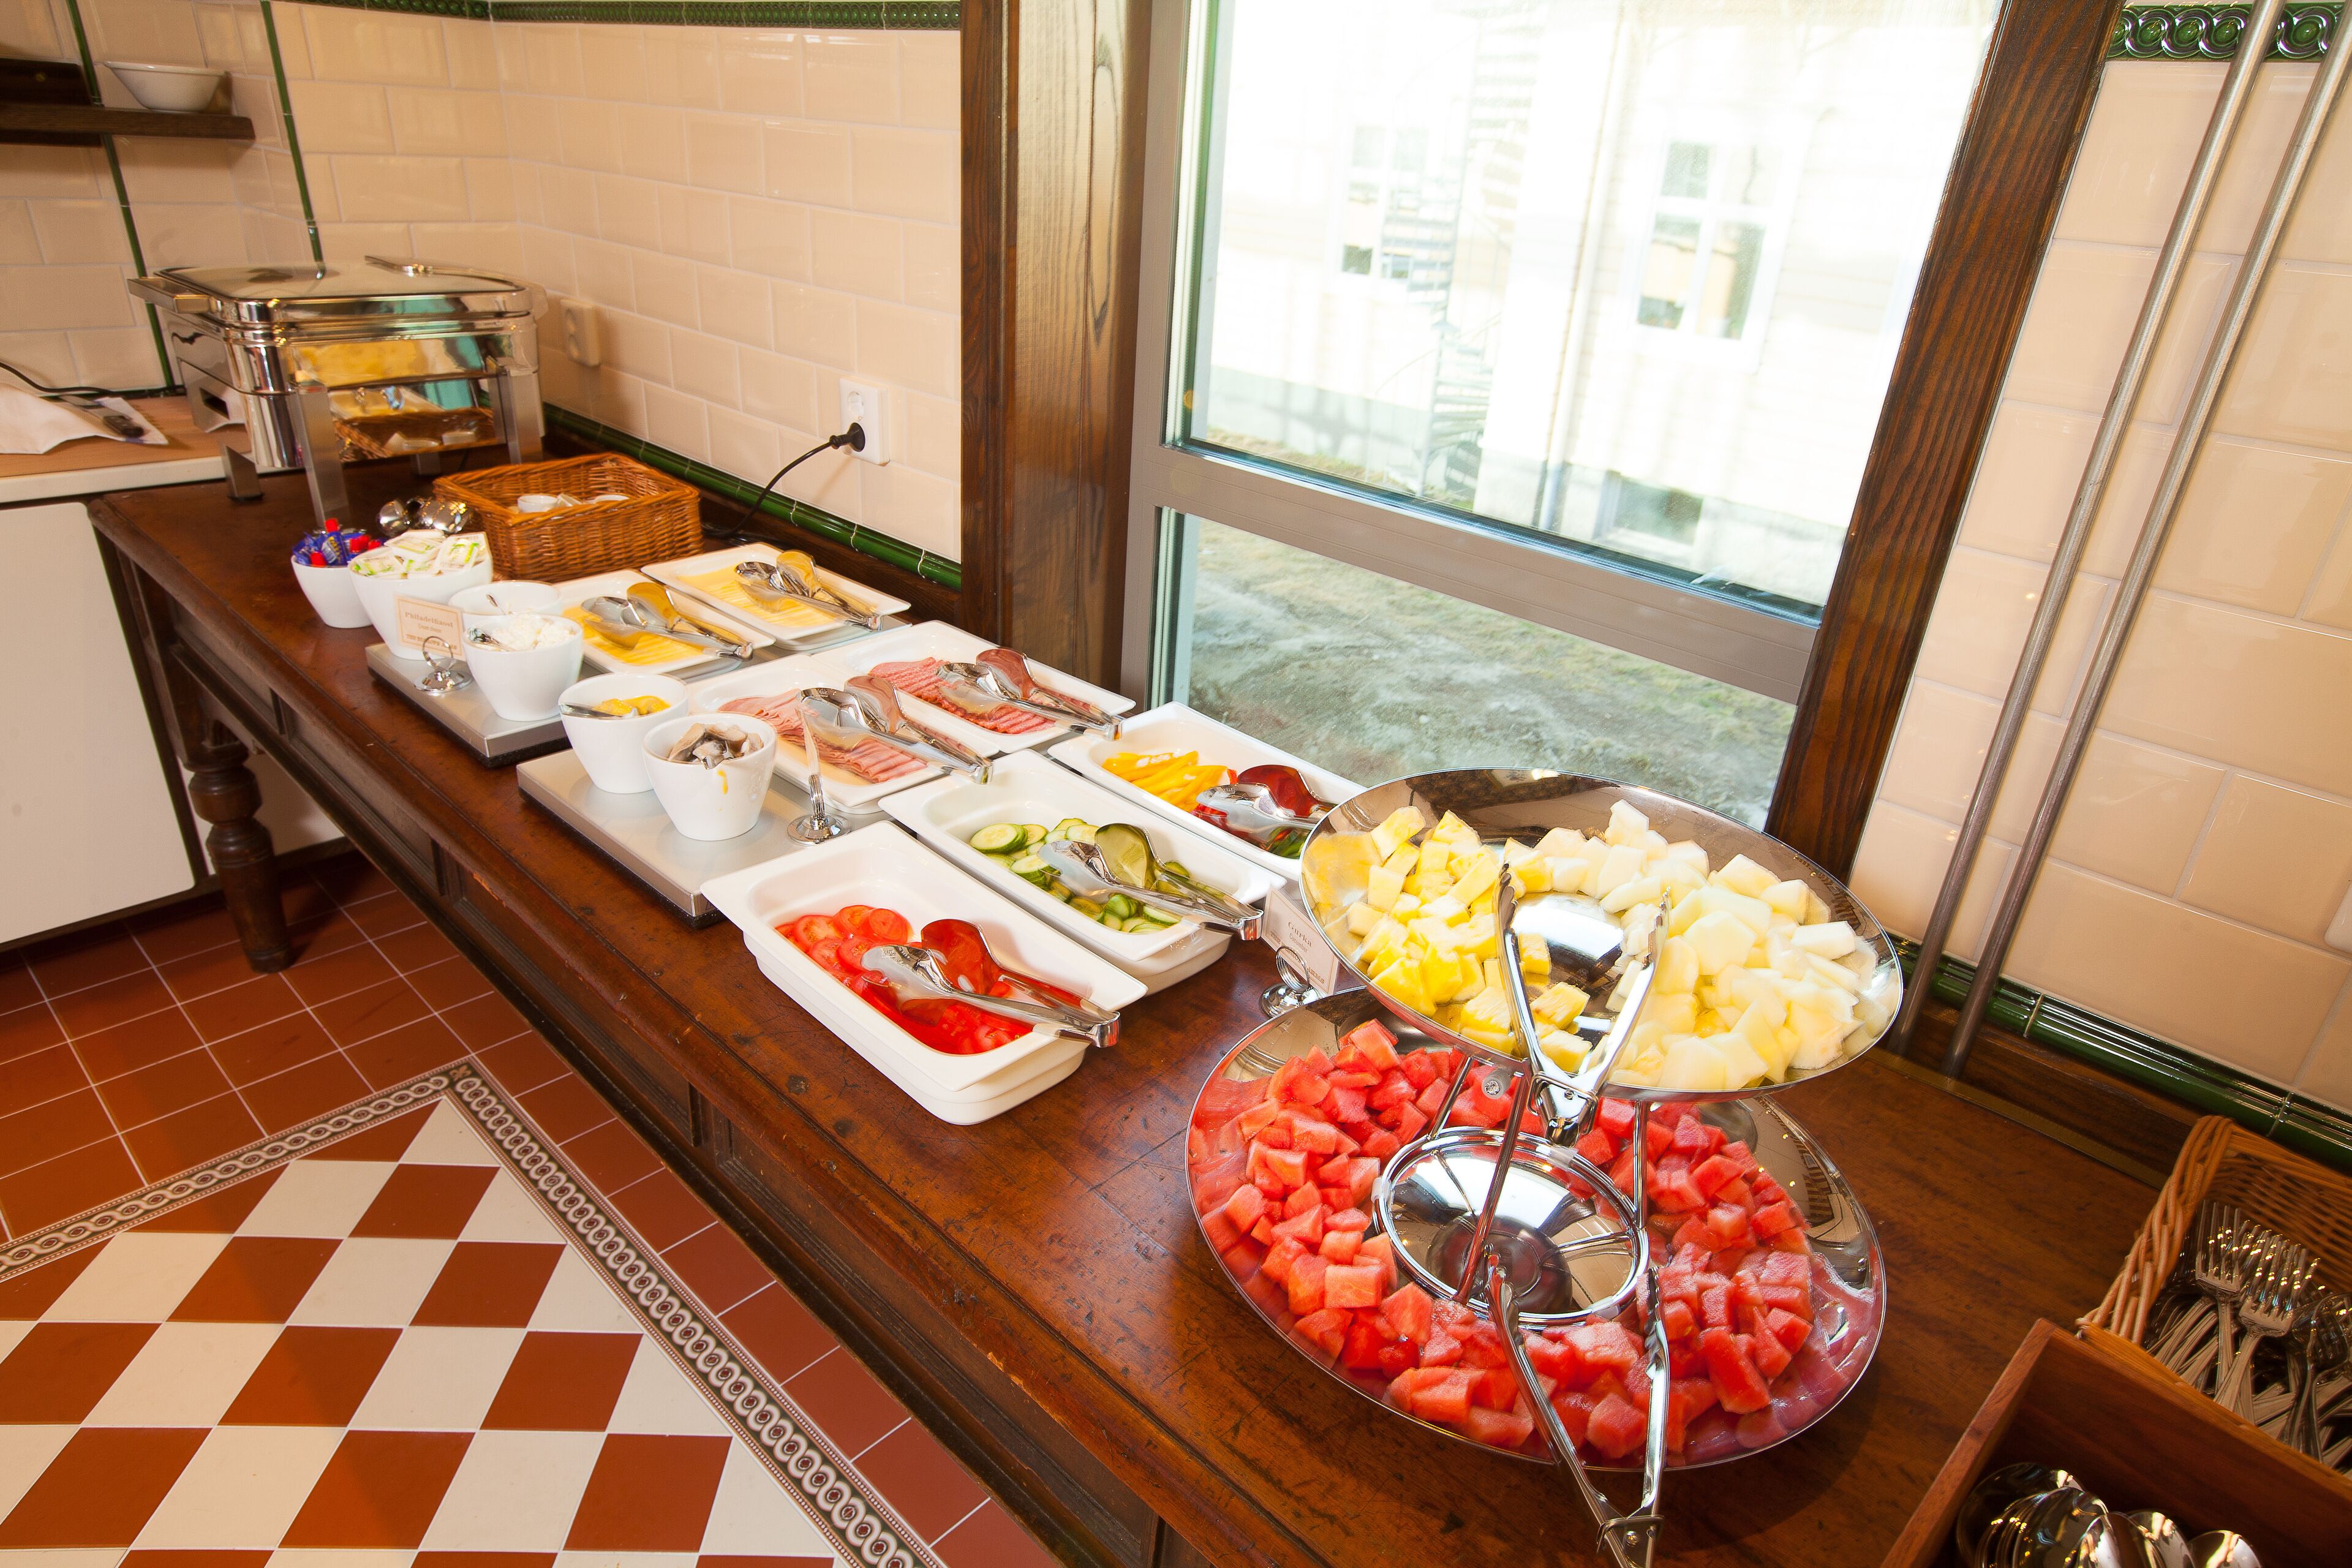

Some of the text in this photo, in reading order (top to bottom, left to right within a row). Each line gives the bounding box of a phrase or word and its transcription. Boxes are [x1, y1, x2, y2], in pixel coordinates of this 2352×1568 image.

[405, 611, 453, 627] Philadelfiaost
[1288, 922, 1312, 947] Gurka
[1289, 933, 1308, 953] Cucumber
